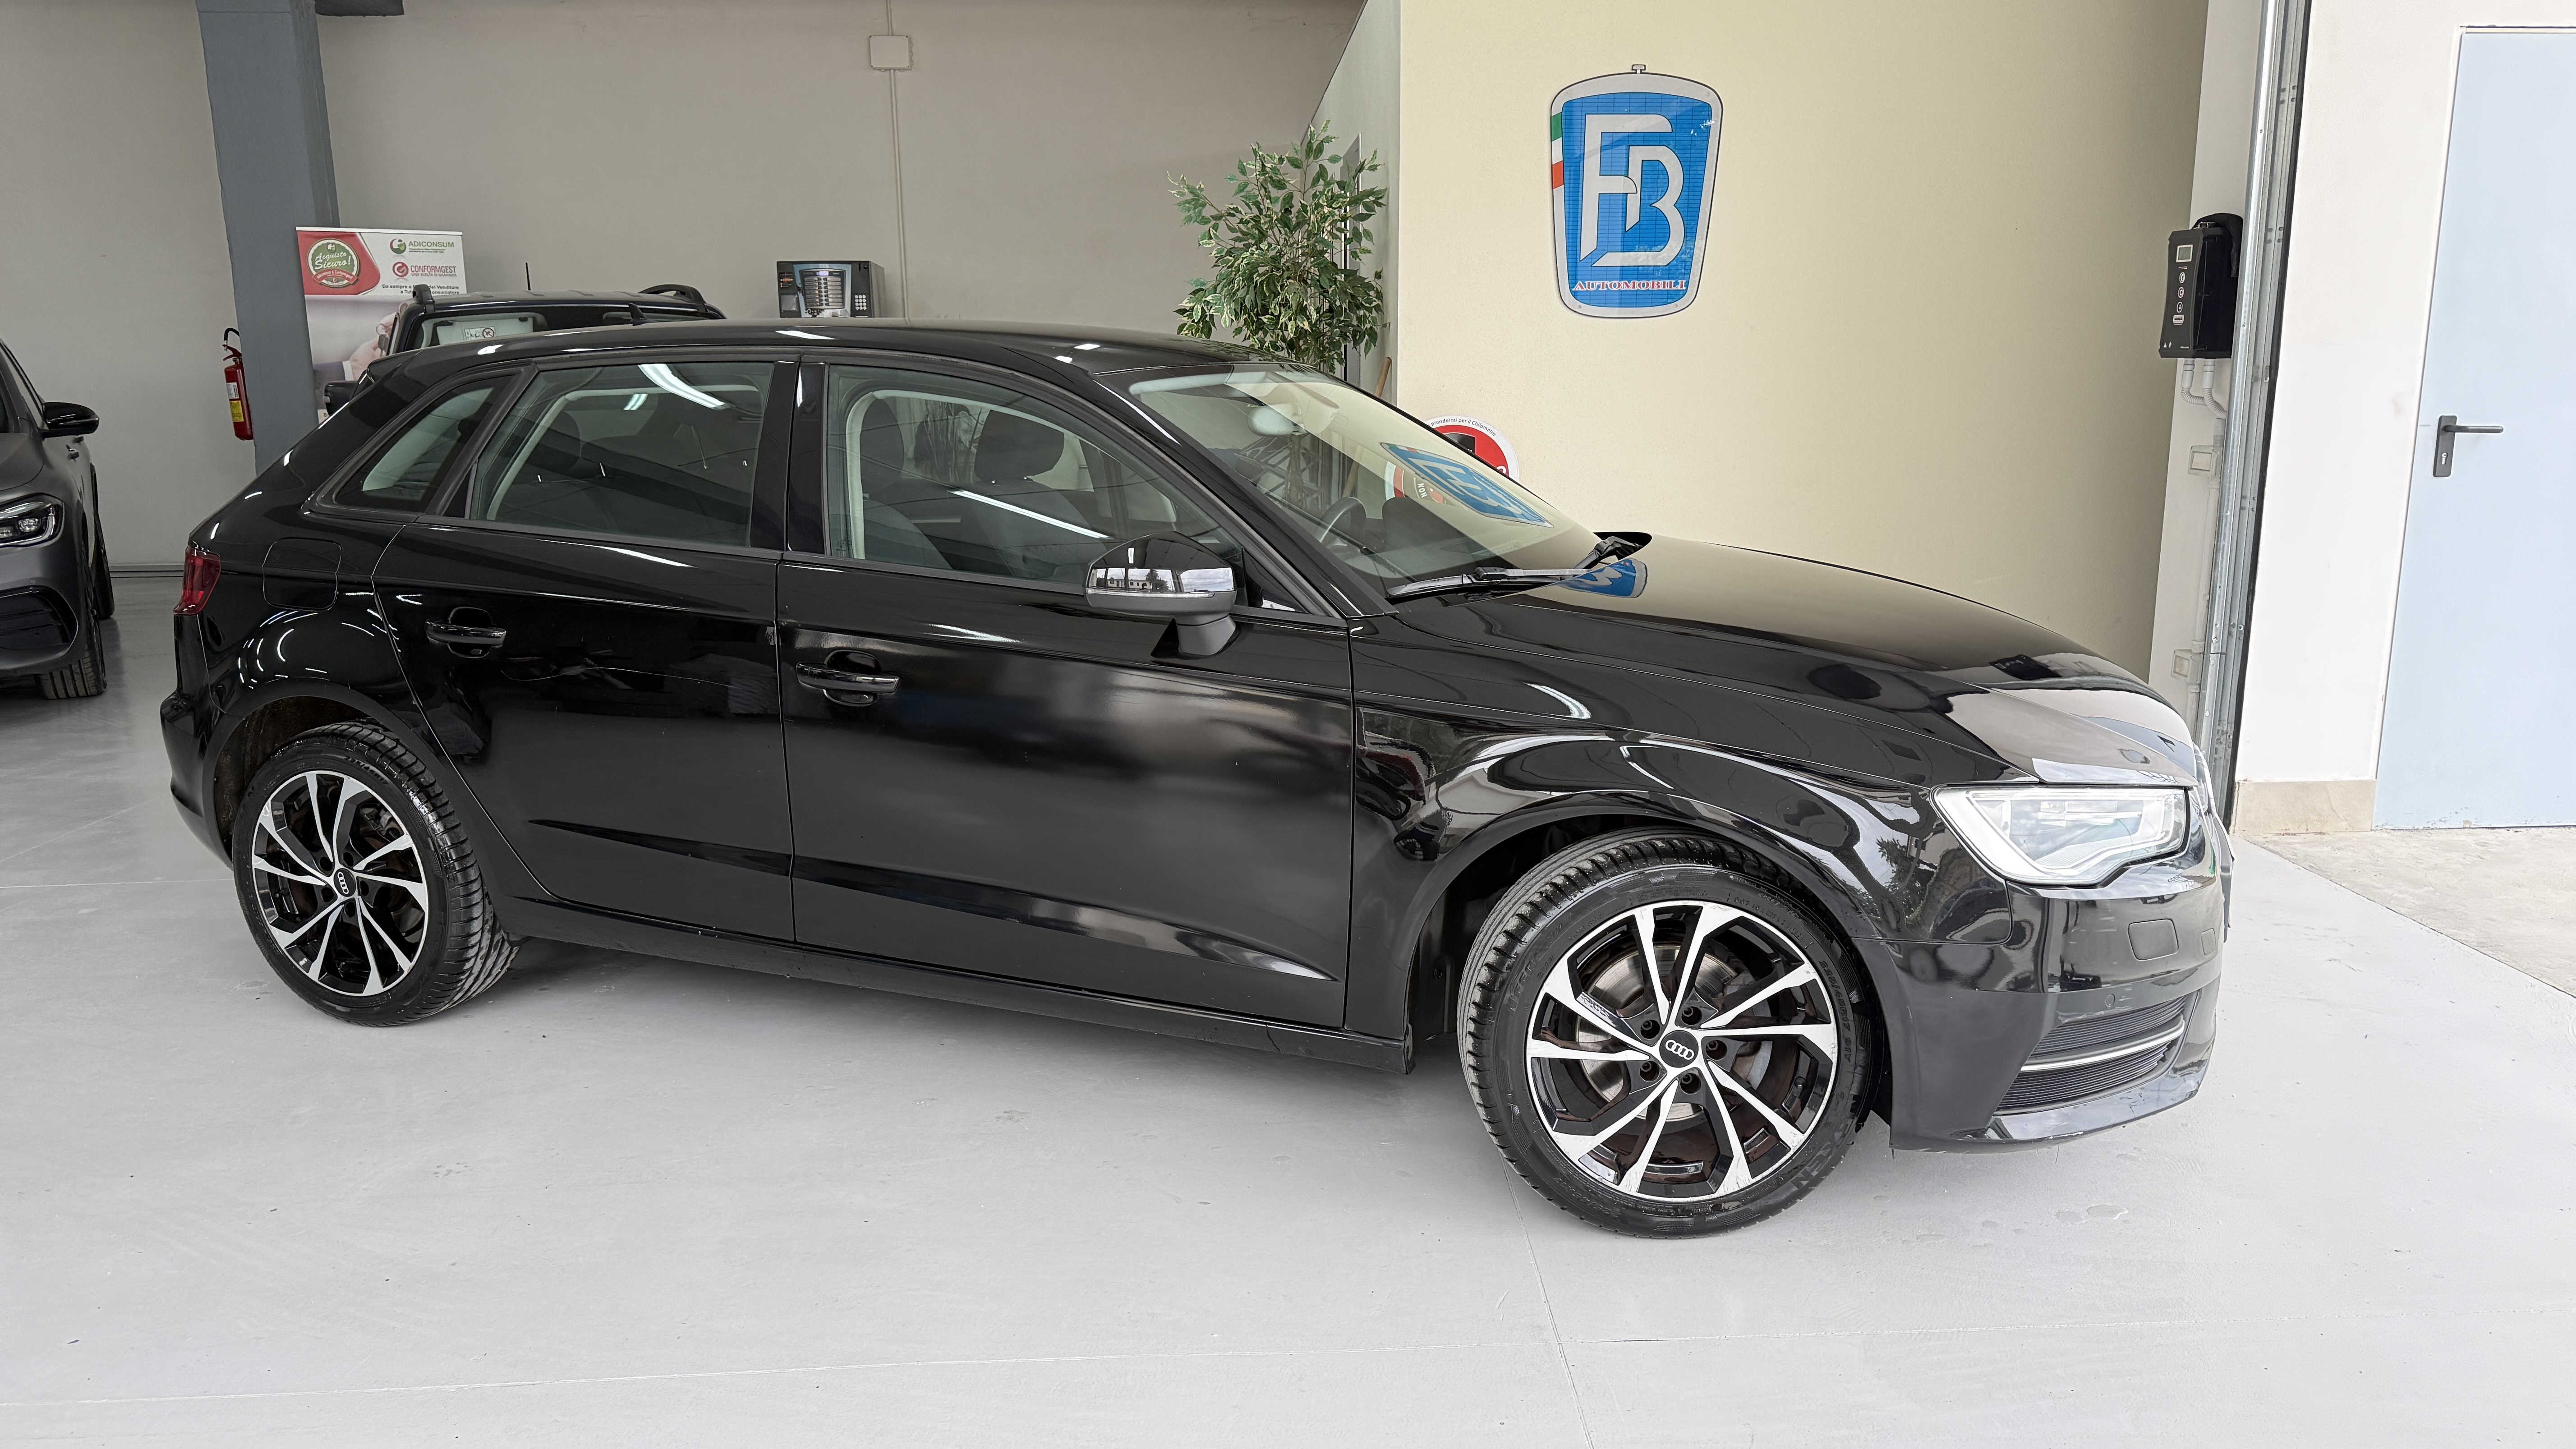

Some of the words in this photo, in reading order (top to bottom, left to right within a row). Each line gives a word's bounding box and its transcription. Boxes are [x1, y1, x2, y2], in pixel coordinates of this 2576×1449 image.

[315, 252, 346, 261] Acquisto
[315, 256, 351, 269] Sicuro!
[411, 265, 456, 273] CONFORMGEST
[1572, 280, 1686, 291] AUTOMOBILI
[1431, 418, 1457, 426] prendermi
[1472, 420, 1496, 436] Chilometro
[1418, 483, 1427, 498] NON
[1817, 959, 1851, 1031] 225/45R17
